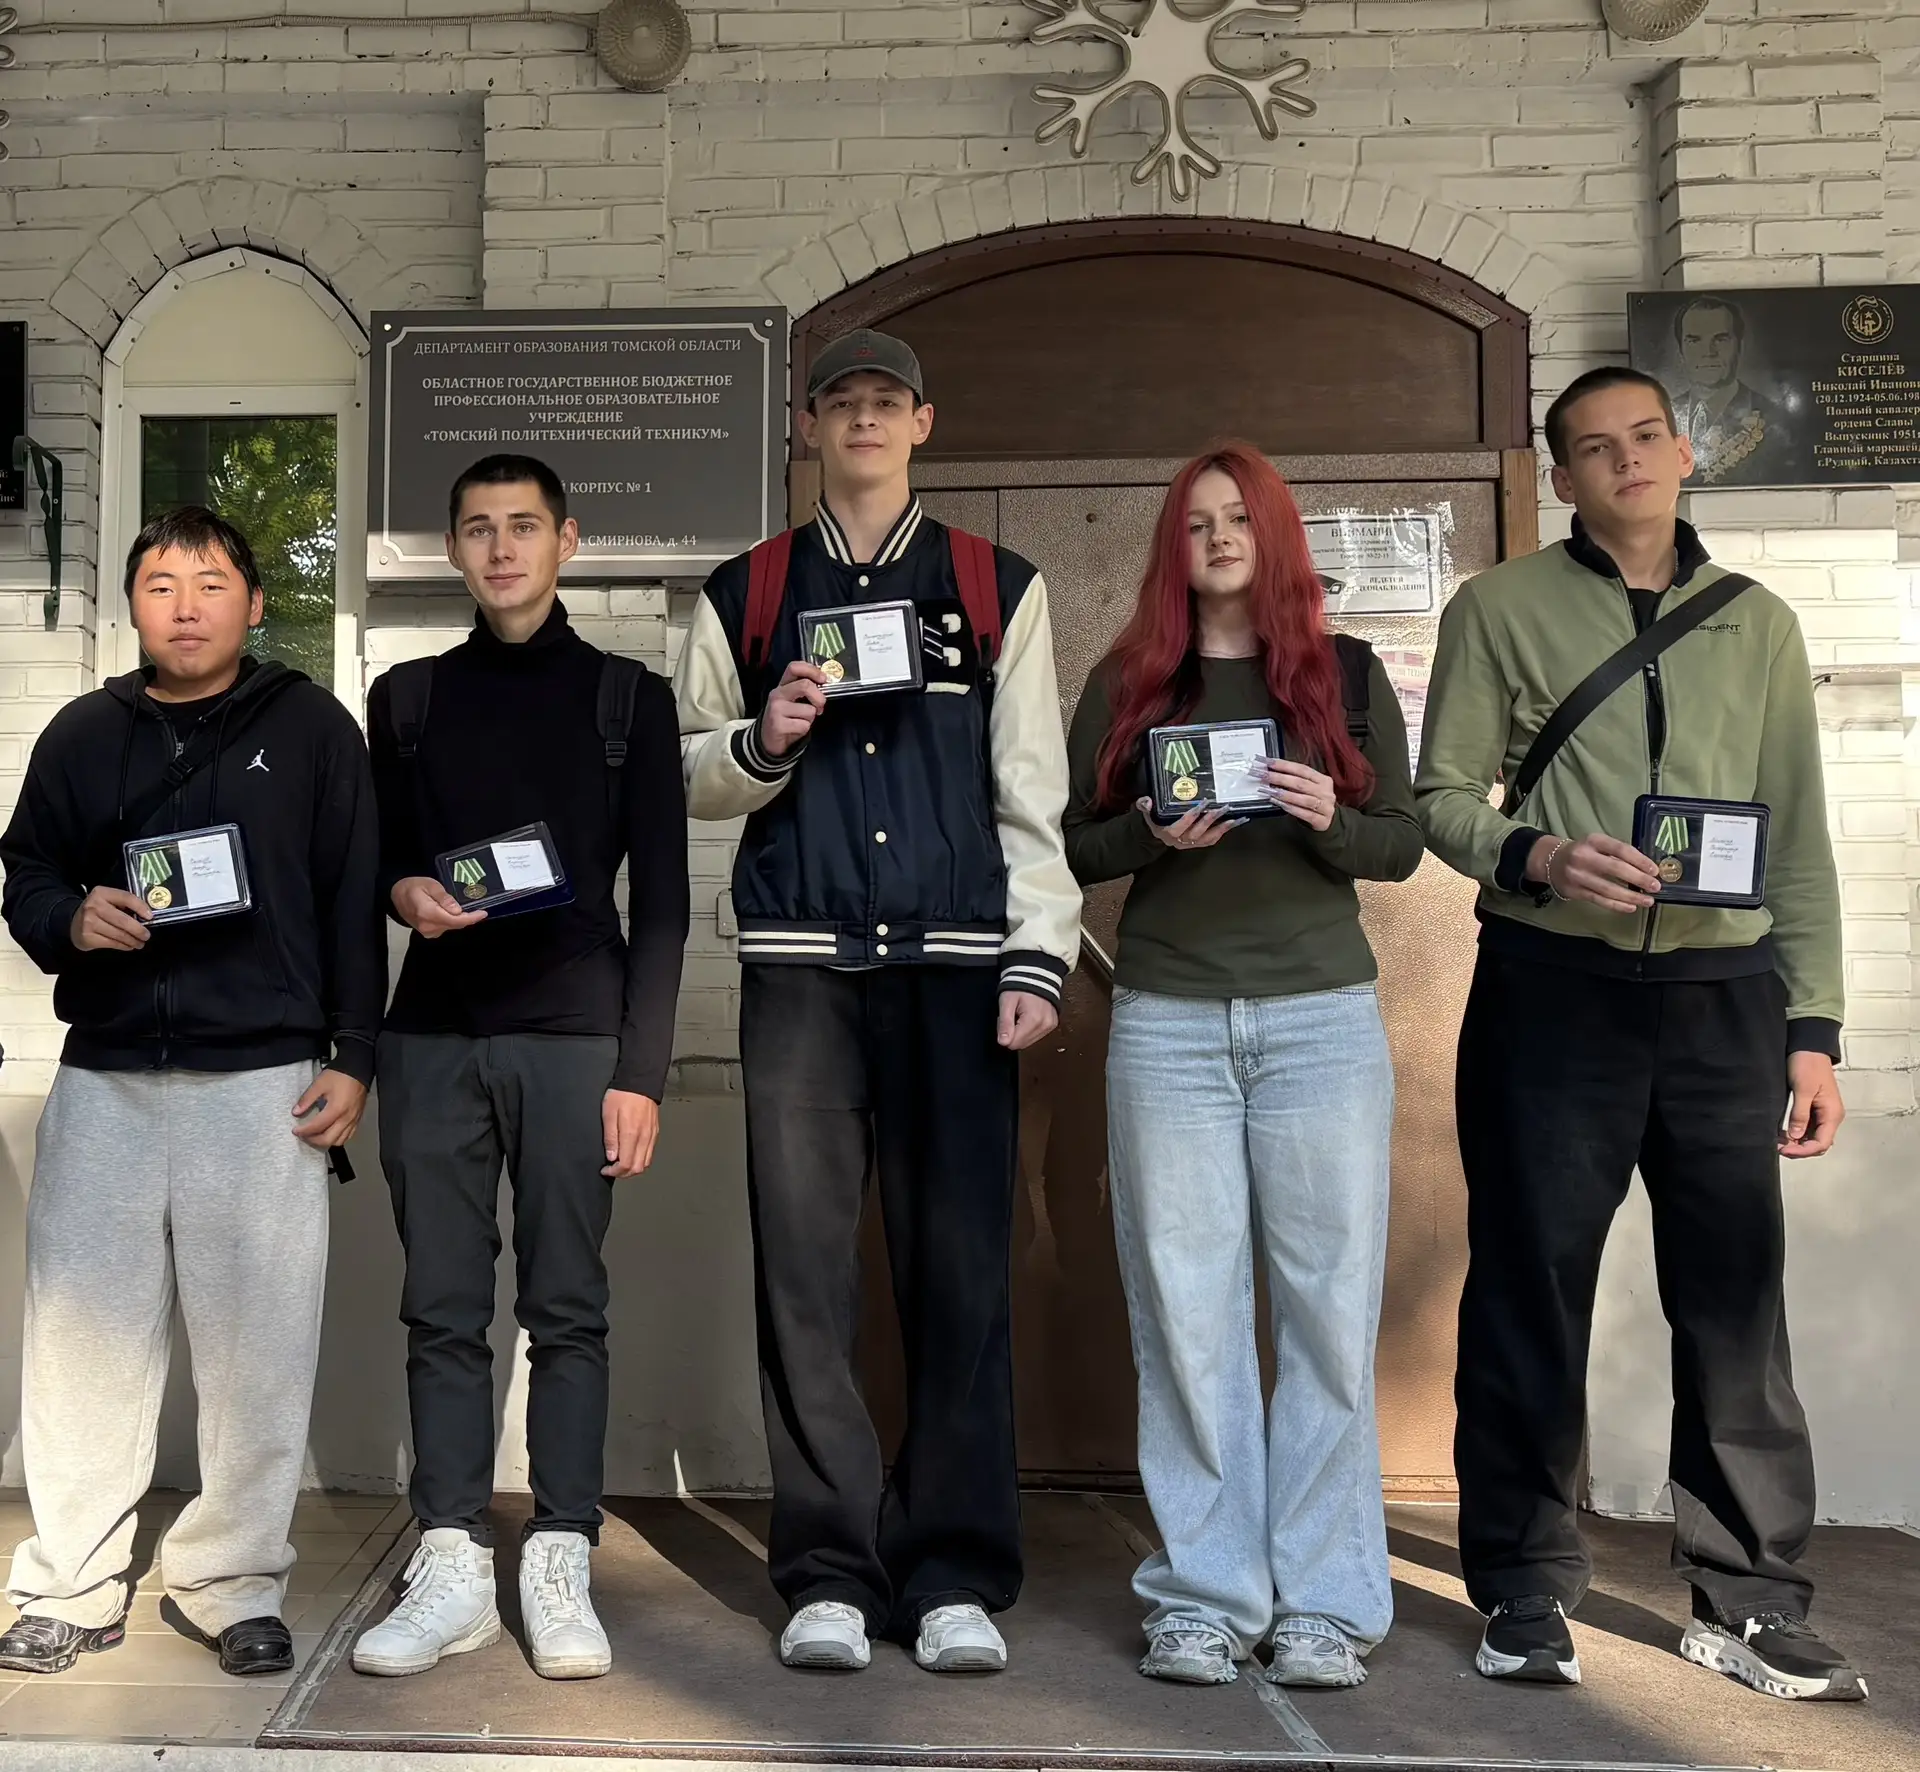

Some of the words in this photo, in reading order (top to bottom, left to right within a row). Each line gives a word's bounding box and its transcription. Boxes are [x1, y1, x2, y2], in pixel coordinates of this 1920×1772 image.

[413, 342, 511, 355] ДЕПАРТАМЕНТ
[513, 341, 608, 353] ОБРАЗОВАНИЯ
[611, 338, 676, 352] ТОМСКОЙ
[679, 339, 742, 351] ОБЛАСТИ
[1841, 353, 1900, 364] Старшина
[1837, 363, 1905, 376] КИСЕЛЁВ
[422, 377, 504, 389] ОБЛАСТНОЕ
[507, 376, 639, 389] ГОСУДАРСТВЕННОЕ
[642, 375, 733, 388] БЮДЖЕТНОЕ
[1811, 380, 1866, 392] Николай
[434, 394, 583, 407] ПРОФЕССИОНАЛЬНОЕ
[586, 393, 720, 405] ОБРАЗОВАТЕЛЬНОЕ
[1826, 406, 1872, 416] Полный
[1876, 406, 1920, 415] кавалер
[529, 411, 624, 424] УЧРЕЖДЕНИЕ
[1834, 420, 1872, 430] ордена
[1875, 417, 1913, 427] Славы
[423, 428, 498, 442] «ТОМСКИЙ
[501, 426, 642, 441] ПОЛИТЕХНИЧЕСКИЙ
[645, 428, 730, 440] ТЕХНИКУМ»
[1824, 431, 1889, 443] Выпускник
[1813, 443, 1863, 454] Главный
[1867, 443, 1920, 454] маркшей
[570, 482, 624, 493] КОРПУС
[626, 482, 641, 493] №
[645, 482, 652, 493] 1
[588, 535, 665, 546] СМИРНОВА,
[667, 537, 678, 547] д.
[681, 535, 697, 546] 44
